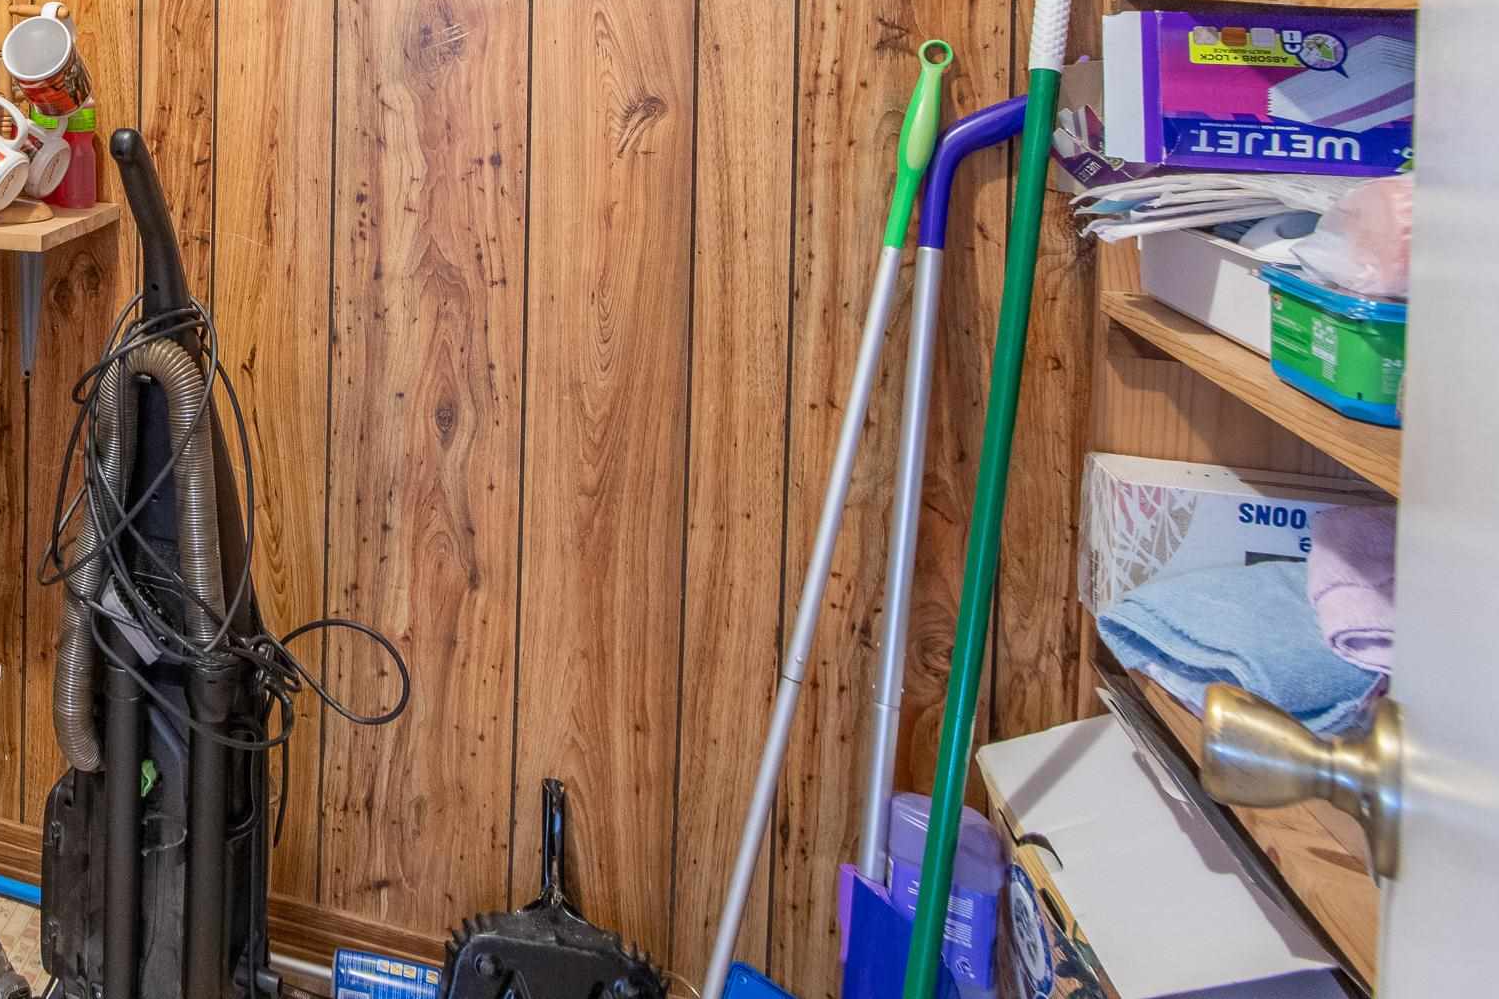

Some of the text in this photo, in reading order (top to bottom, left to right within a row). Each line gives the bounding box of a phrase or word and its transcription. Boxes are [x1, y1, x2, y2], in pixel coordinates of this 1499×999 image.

[1200, 54, 1230, 62] LOCK
[1242, 55, 1289, 64] ABSORB
[1190, 130, 1360, 161] WETJET
[1238, 502, 1312, 530] SNOO
